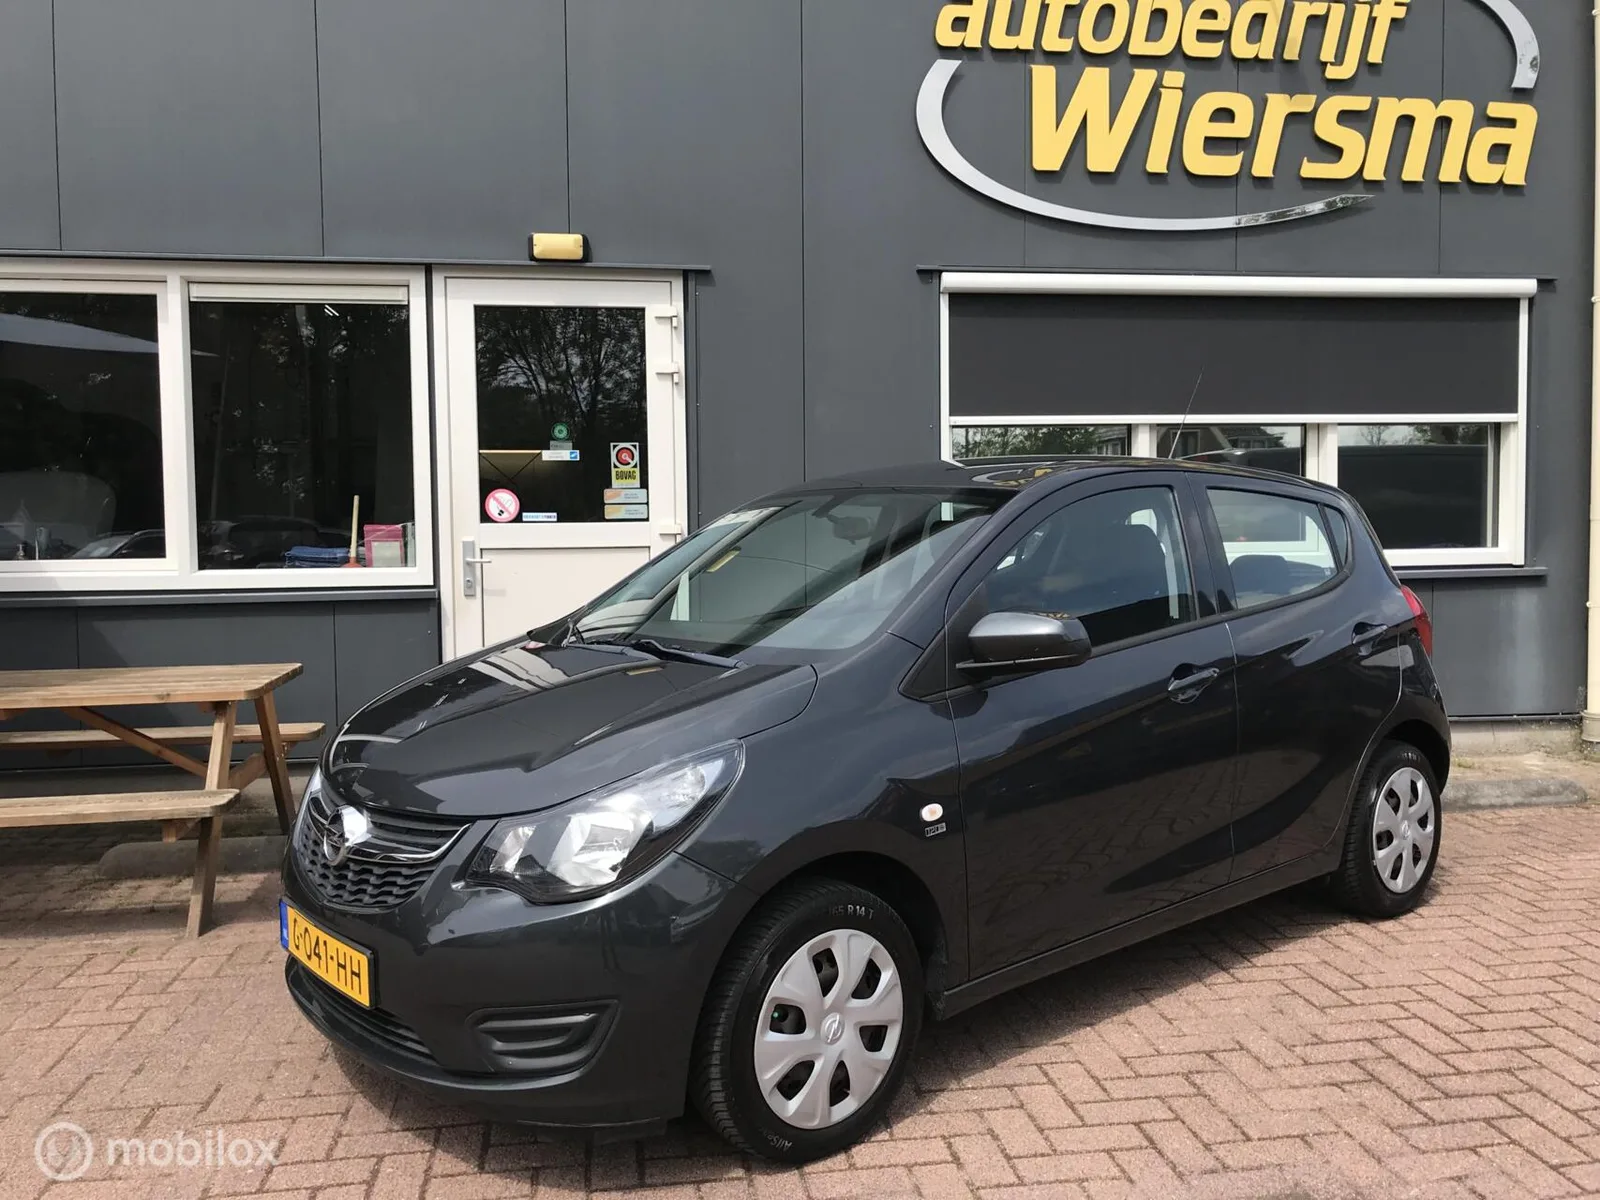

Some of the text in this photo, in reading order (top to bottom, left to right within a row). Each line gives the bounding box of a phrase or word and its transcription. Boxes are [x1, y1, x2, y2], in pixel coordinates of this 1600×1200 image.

[935, 0, 1411, 80] autobedrijf
[1030, 65, 1538, 185] Wiersma
[615, 470, 637, 481] BOVAG
[293, 917, 362, 995] G-041-HH
